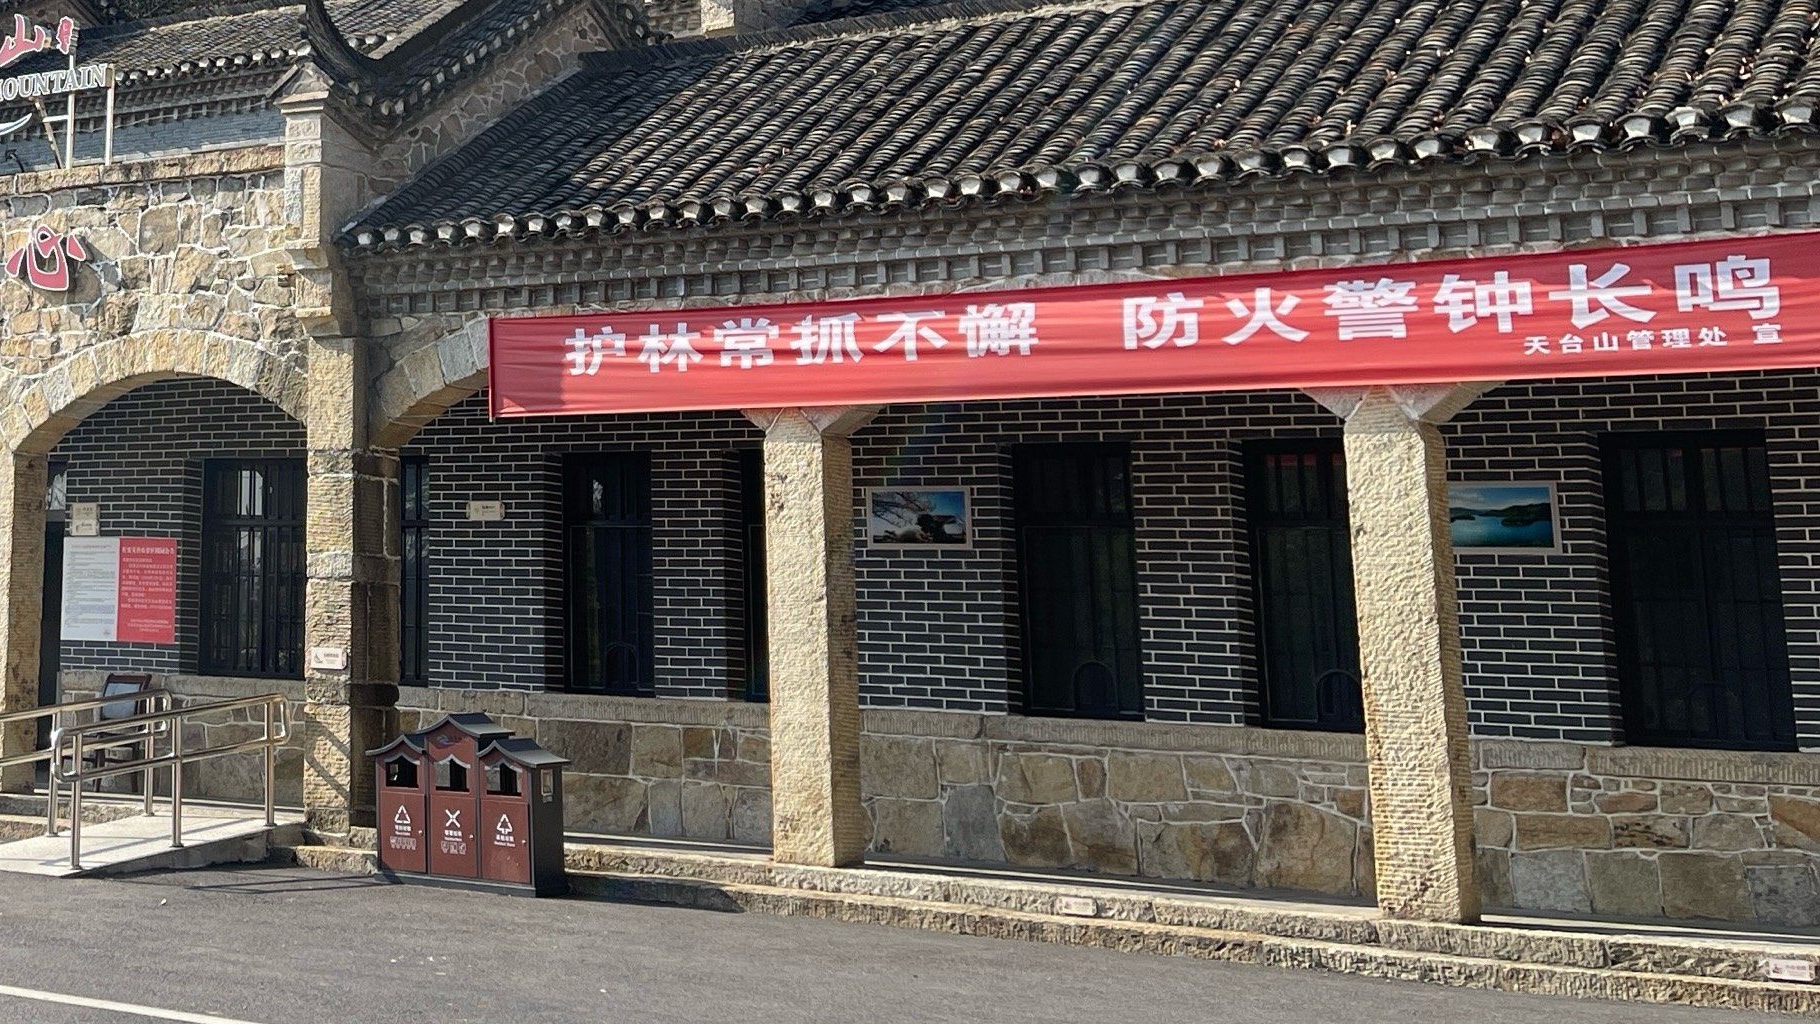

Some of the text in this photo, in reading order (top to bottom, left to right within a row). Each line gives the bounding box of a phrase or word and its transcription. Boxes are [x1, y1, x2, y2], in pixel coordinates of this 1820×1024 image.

[564, 255, 1782, 376] 护林常抓不懈 防火警钟长鸣
[1523, 323, 1783, 355] 天台山管理处 宣
